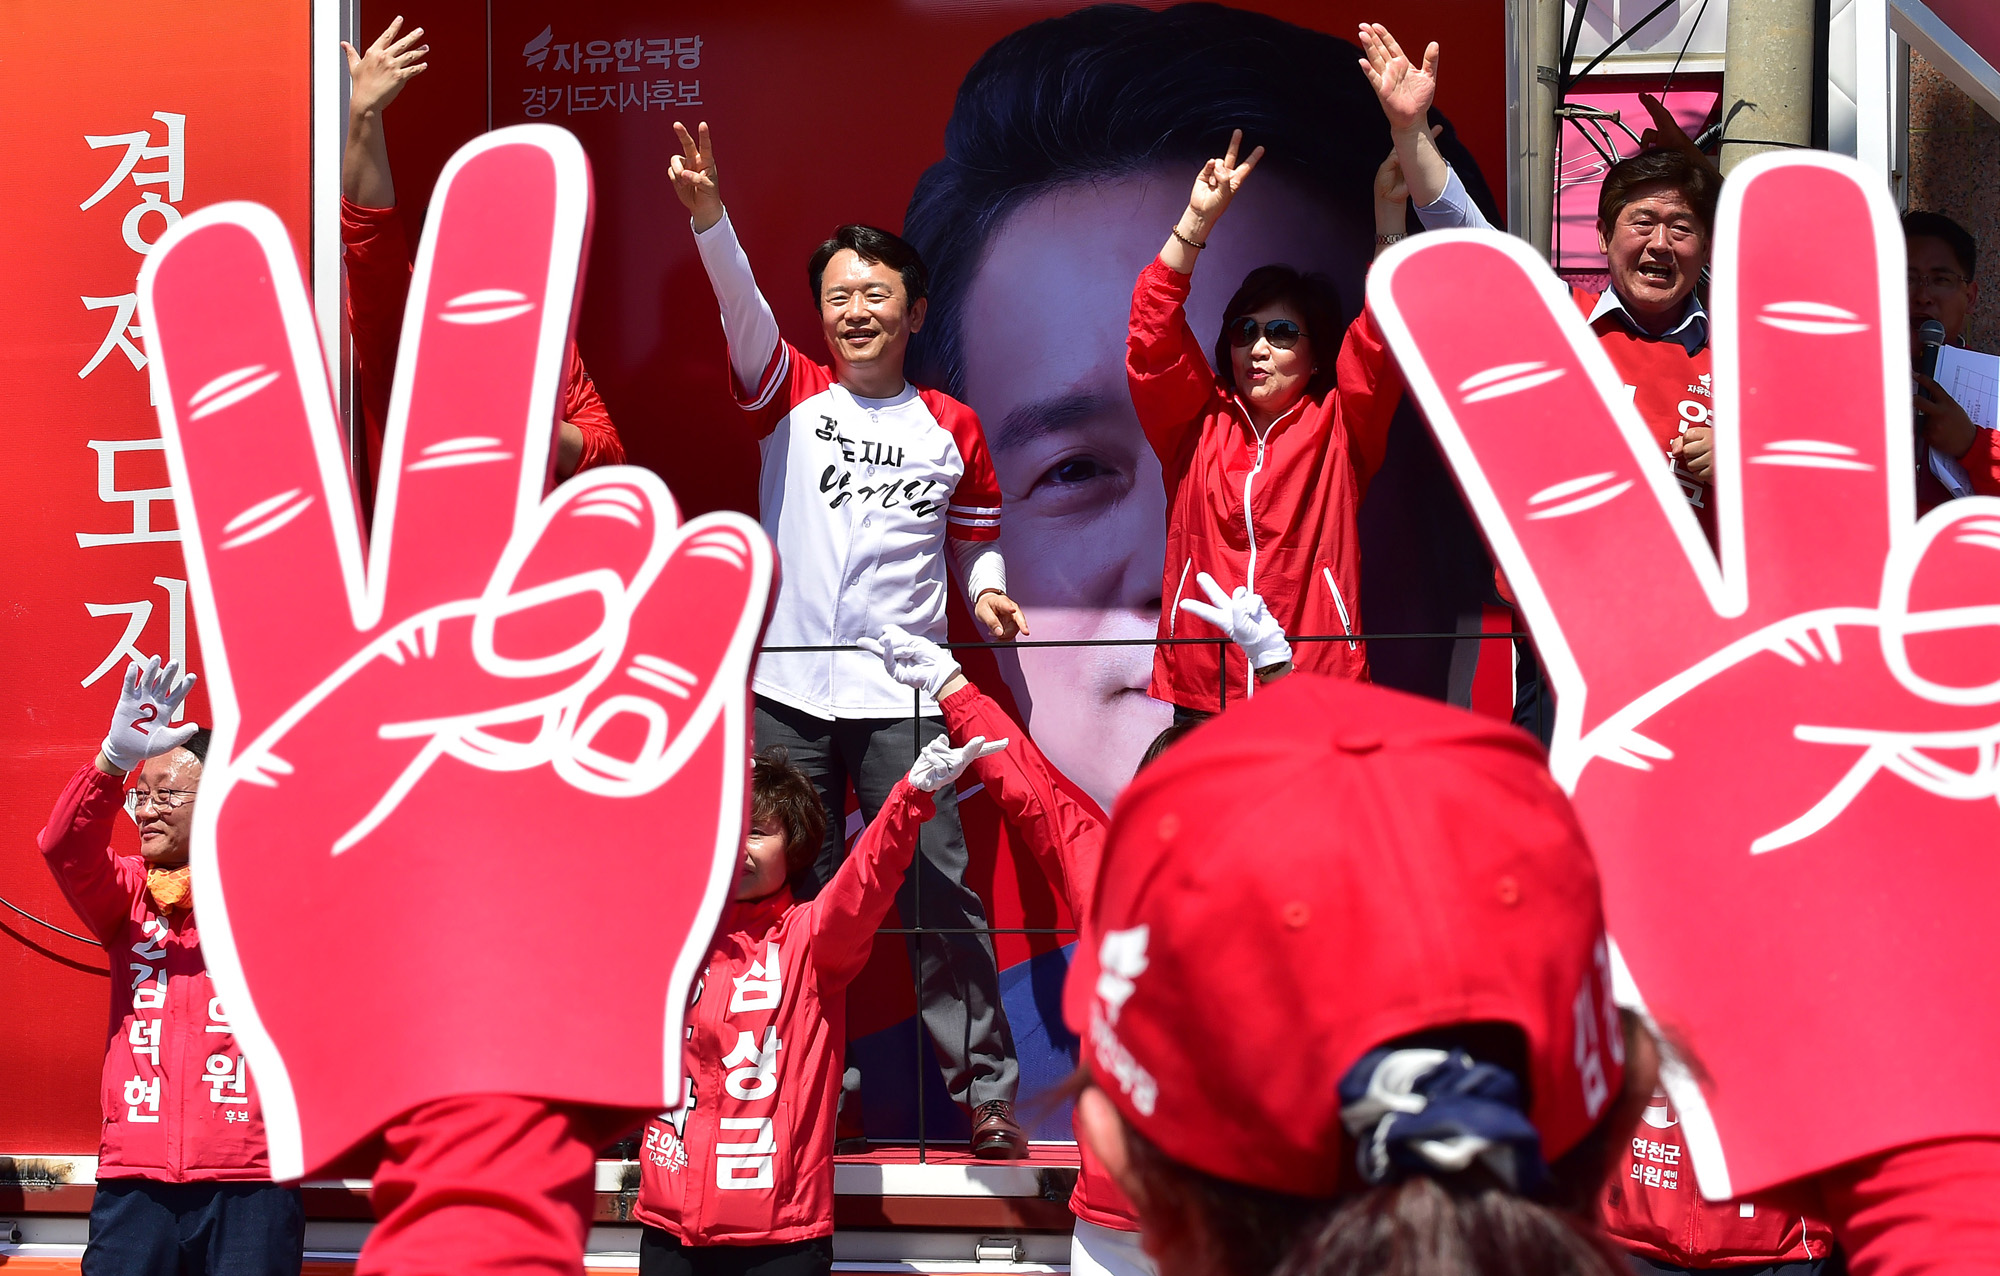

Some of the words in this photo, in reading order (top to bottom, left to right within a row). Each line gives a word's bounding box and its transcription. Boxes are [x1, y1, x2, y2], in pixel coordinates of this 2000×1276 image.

[553, 34, 704, 75] 자유한국당
[522, 79, 704, 118] 경기도지사후보
[130, 702, 158, 735] 2
[123, 962, 168, 1123] 김덕현
[715, 941, 783, 1190] 심상금
[224, 1109, 250, 1124] 후보
[1631, 1137, 1681, 1165] 연천군
[1630, 1163, 1662, 1188] 의원
[1663, 1169, 1678, 1180] 예비
[1661, 1180, 1678, 1190] 후보
